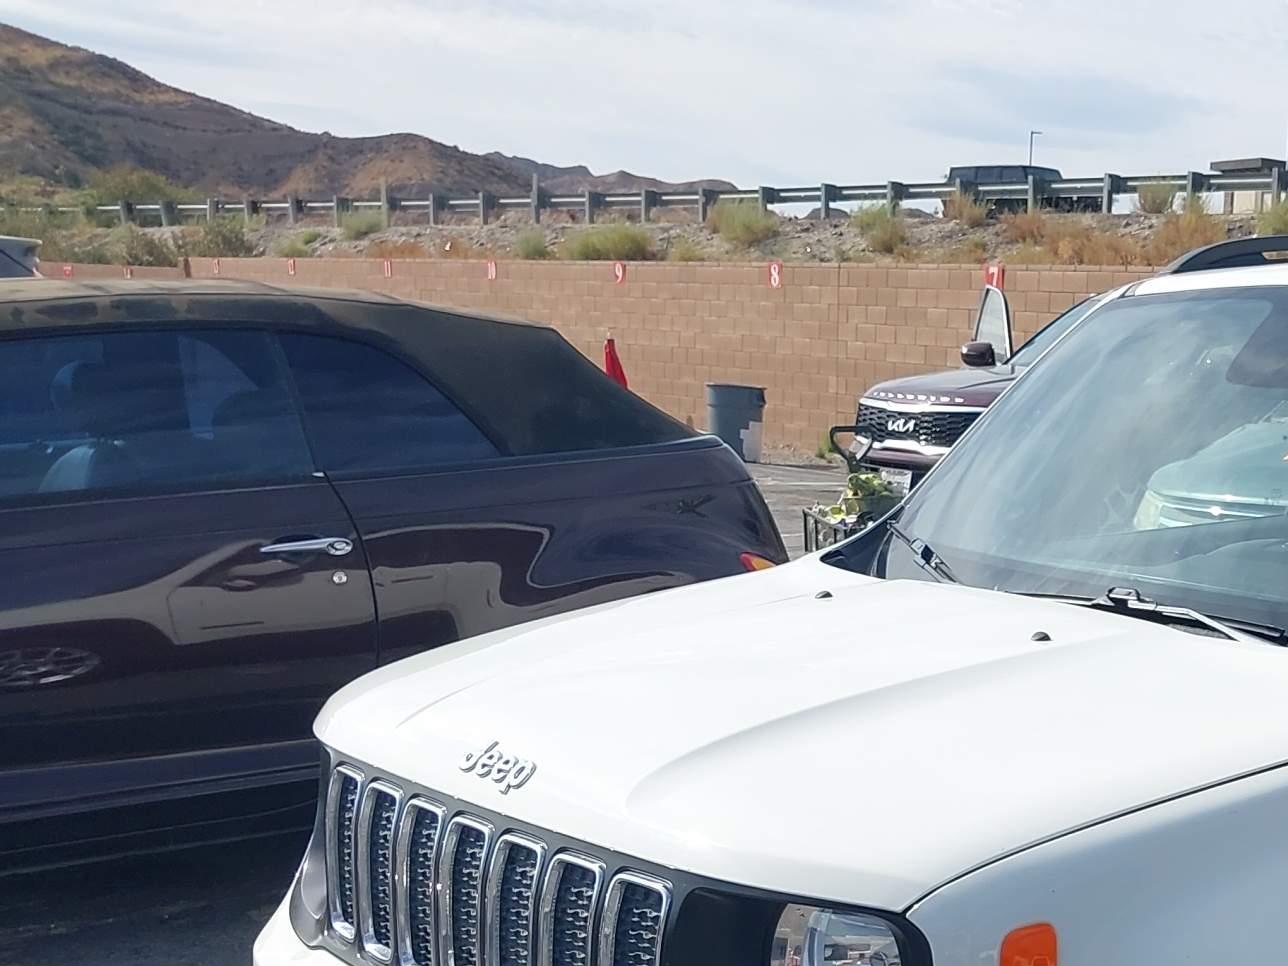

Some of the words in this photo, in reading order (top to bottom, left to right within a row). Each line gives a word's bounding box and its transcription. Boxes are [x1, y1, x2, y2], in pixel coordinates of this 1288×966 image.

[614, 263, 623, 283] 9
[770, 264, 780, 287] 8
[988, 266, 999, 288] 7
[459, 741, 537, 795] Jeep
